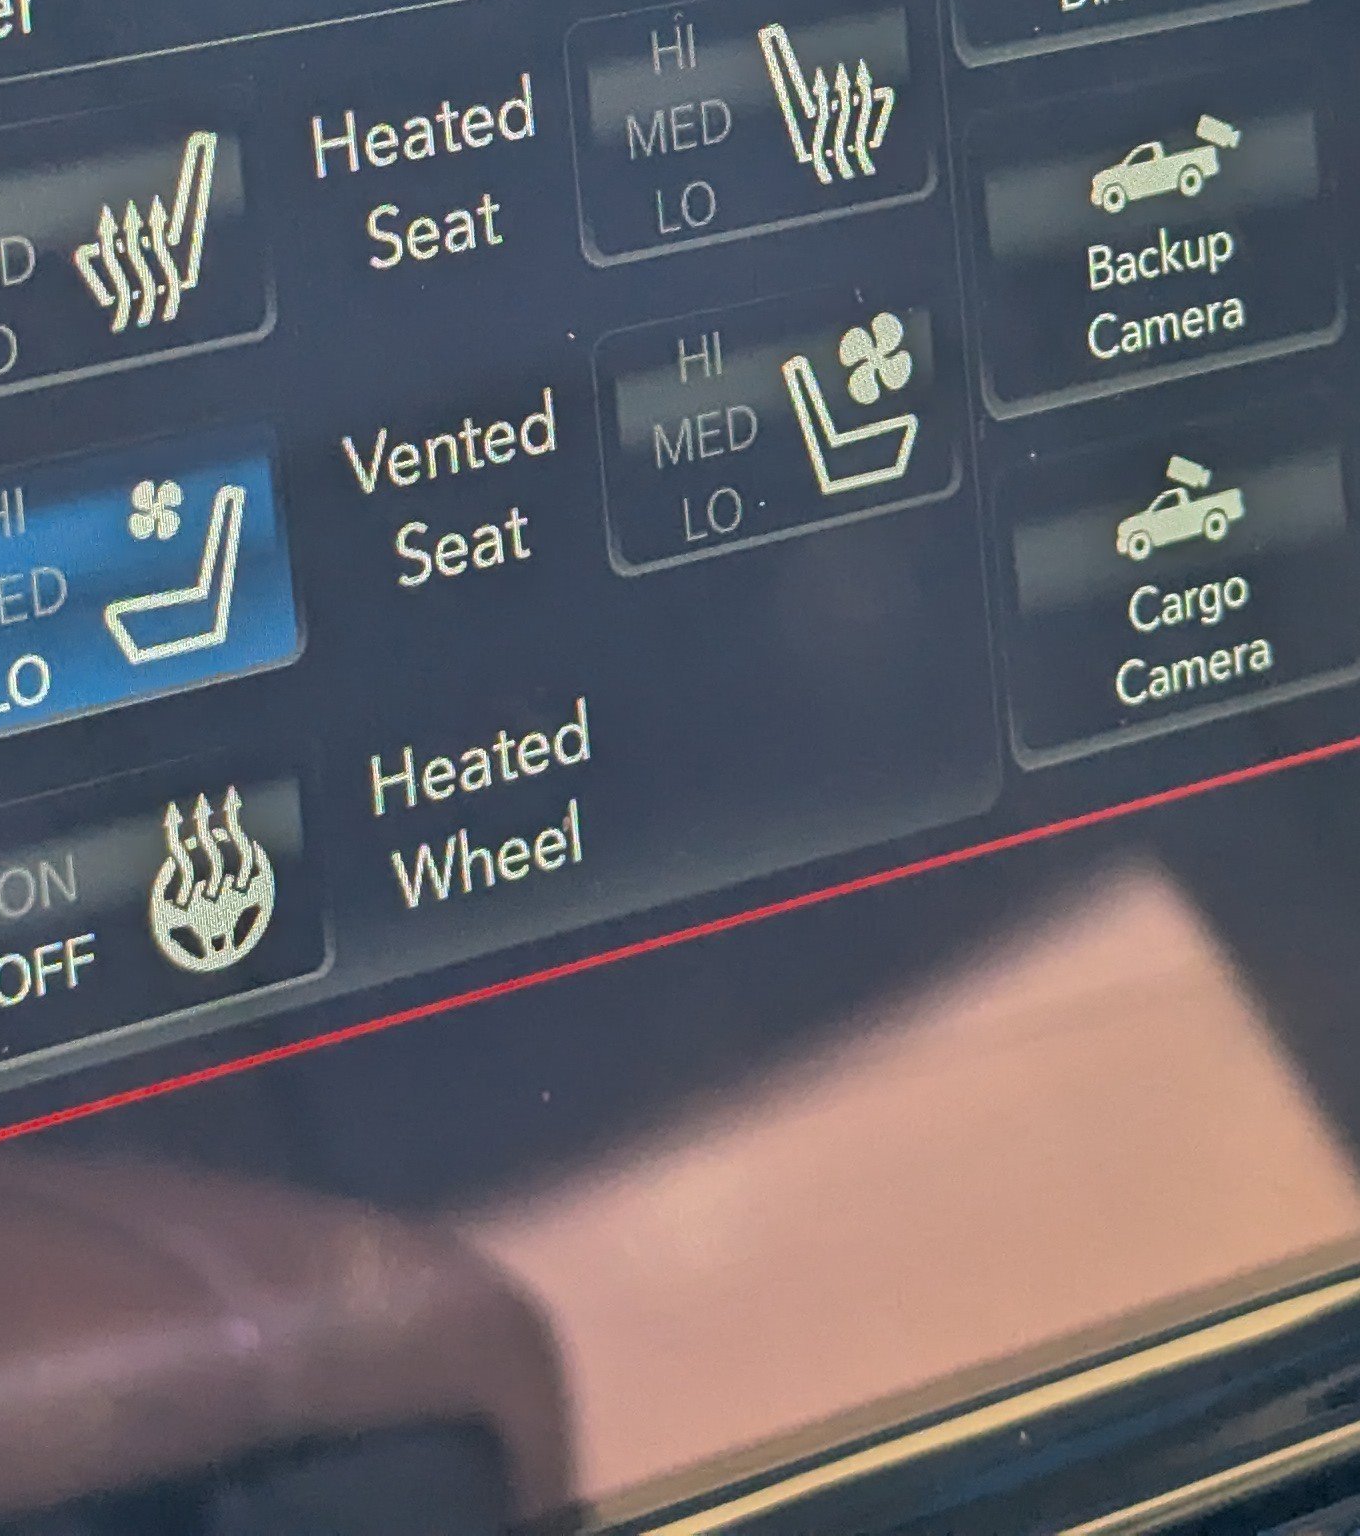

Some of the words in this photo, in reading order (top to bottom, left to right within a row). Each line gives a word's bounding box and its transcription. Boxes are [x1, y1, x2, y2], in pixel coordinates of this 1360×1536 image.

[650, 22, 698, 75] HI
[311, 73, 536, 179] Heated
[625, 98, 733, 160] MED
[367, 194, 504, 269] Seat
[656, 180, 717, 235] LO
[1087, 228, 1235, 292] Backup
[677, 330, 723, 384] HI
[1087, 295, 1246, 360] Camera
[342, 386, 557, 495] Vented
[653, 404, 759, 470] MED
[396, 507, 533, 587] Seat
[683, 487, 742, 542] LO
[1127, 573, 1250, 635] Cargo
[1114, 637, 1273, 707] Camera
[369, 696, 592, 817] Heated
[390, 798, 584, 908] Wheel
